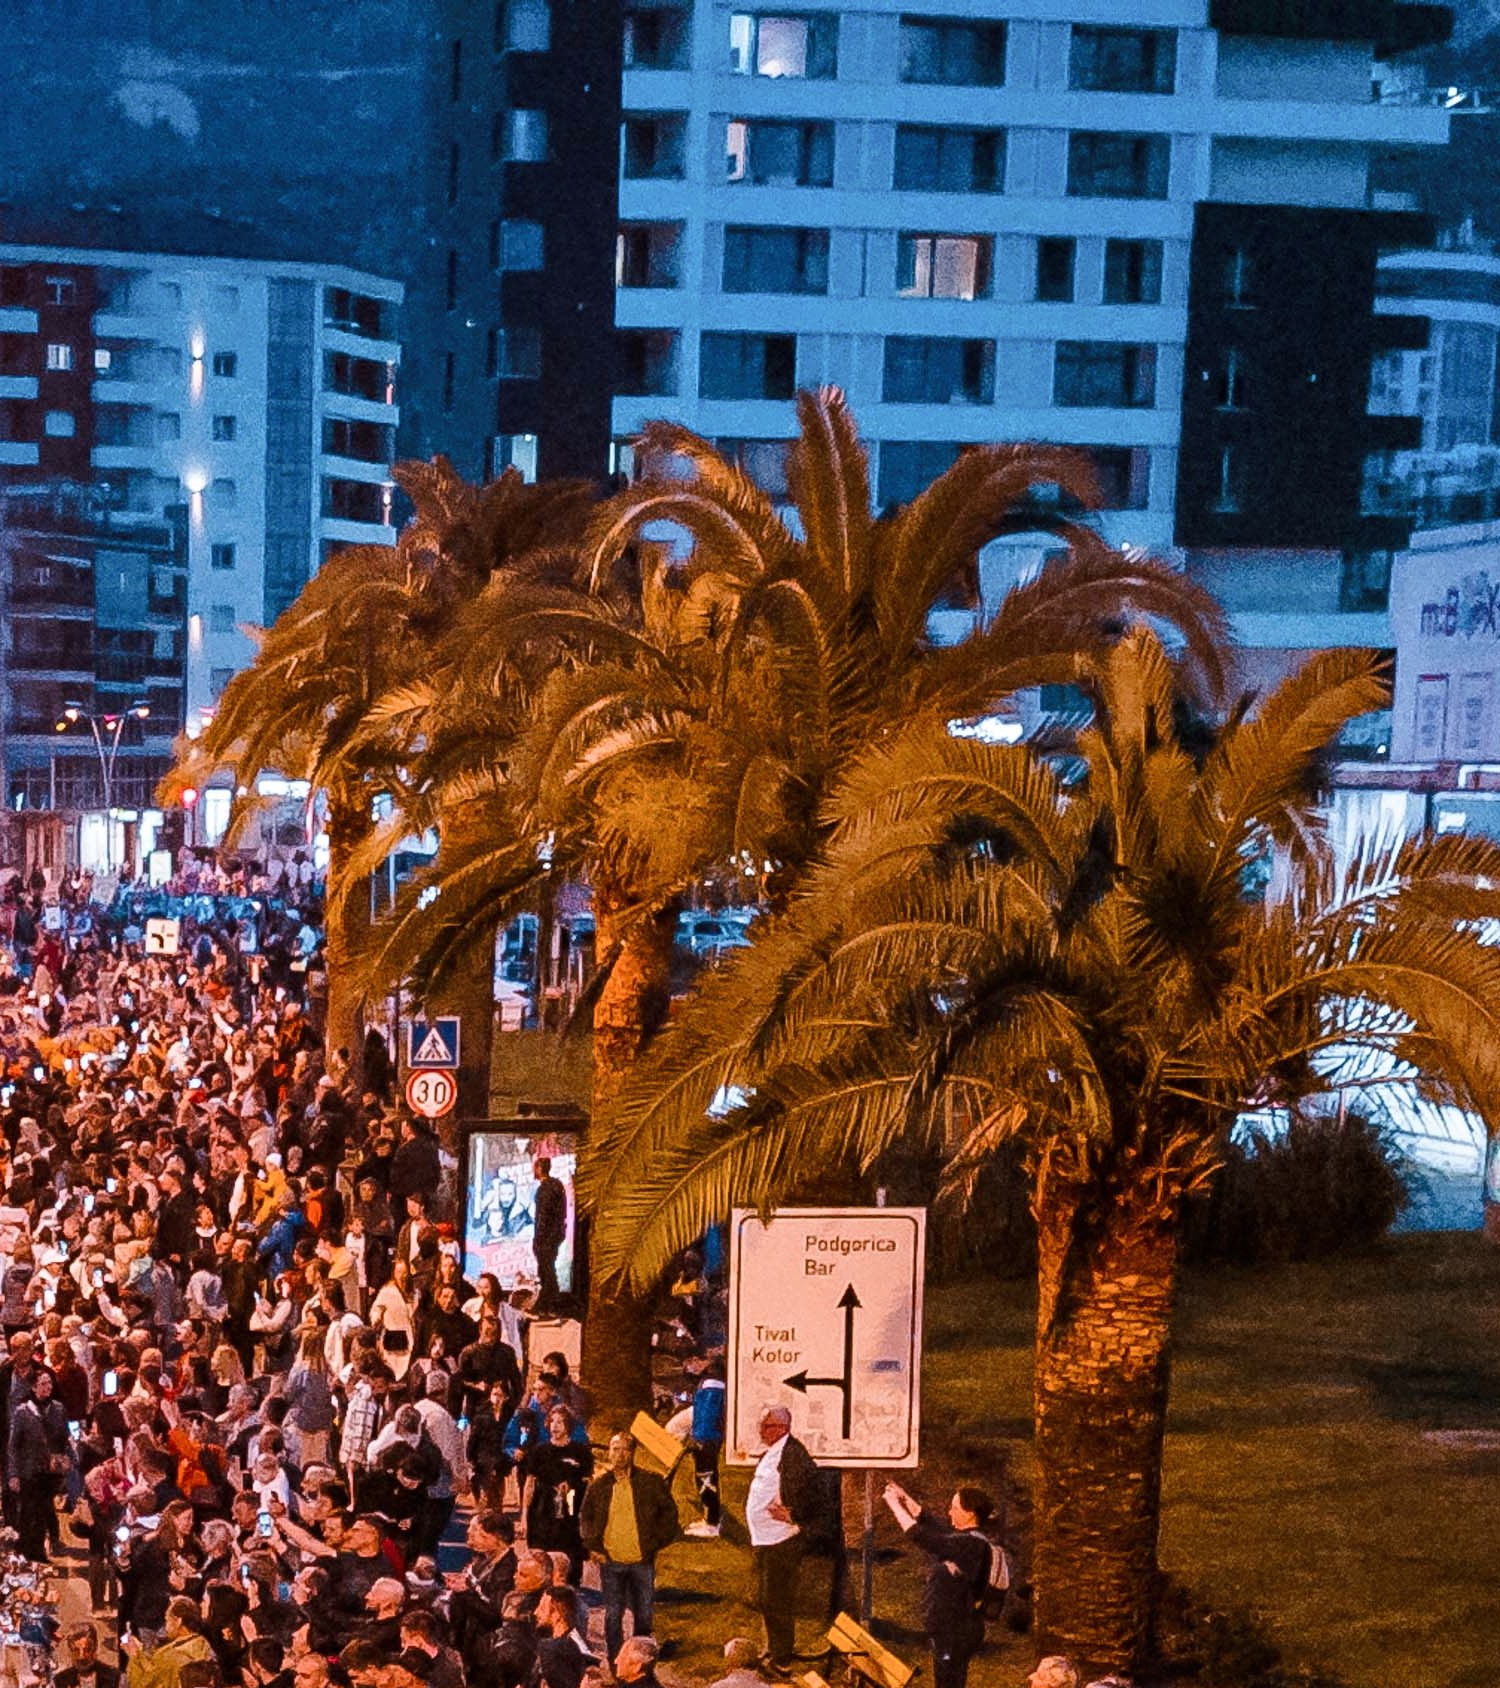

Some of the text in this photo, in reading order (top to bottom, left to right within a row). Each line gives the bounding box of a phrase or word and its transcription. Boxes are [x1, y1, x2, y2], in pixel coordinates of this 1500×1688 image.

[416, 1080, 447, 1105] 30
[805, 1235, 896, 1256] Podgorica
[804, 1259, 836, 1276] Bar
[752, 1347, 801, 1364] Kotor
